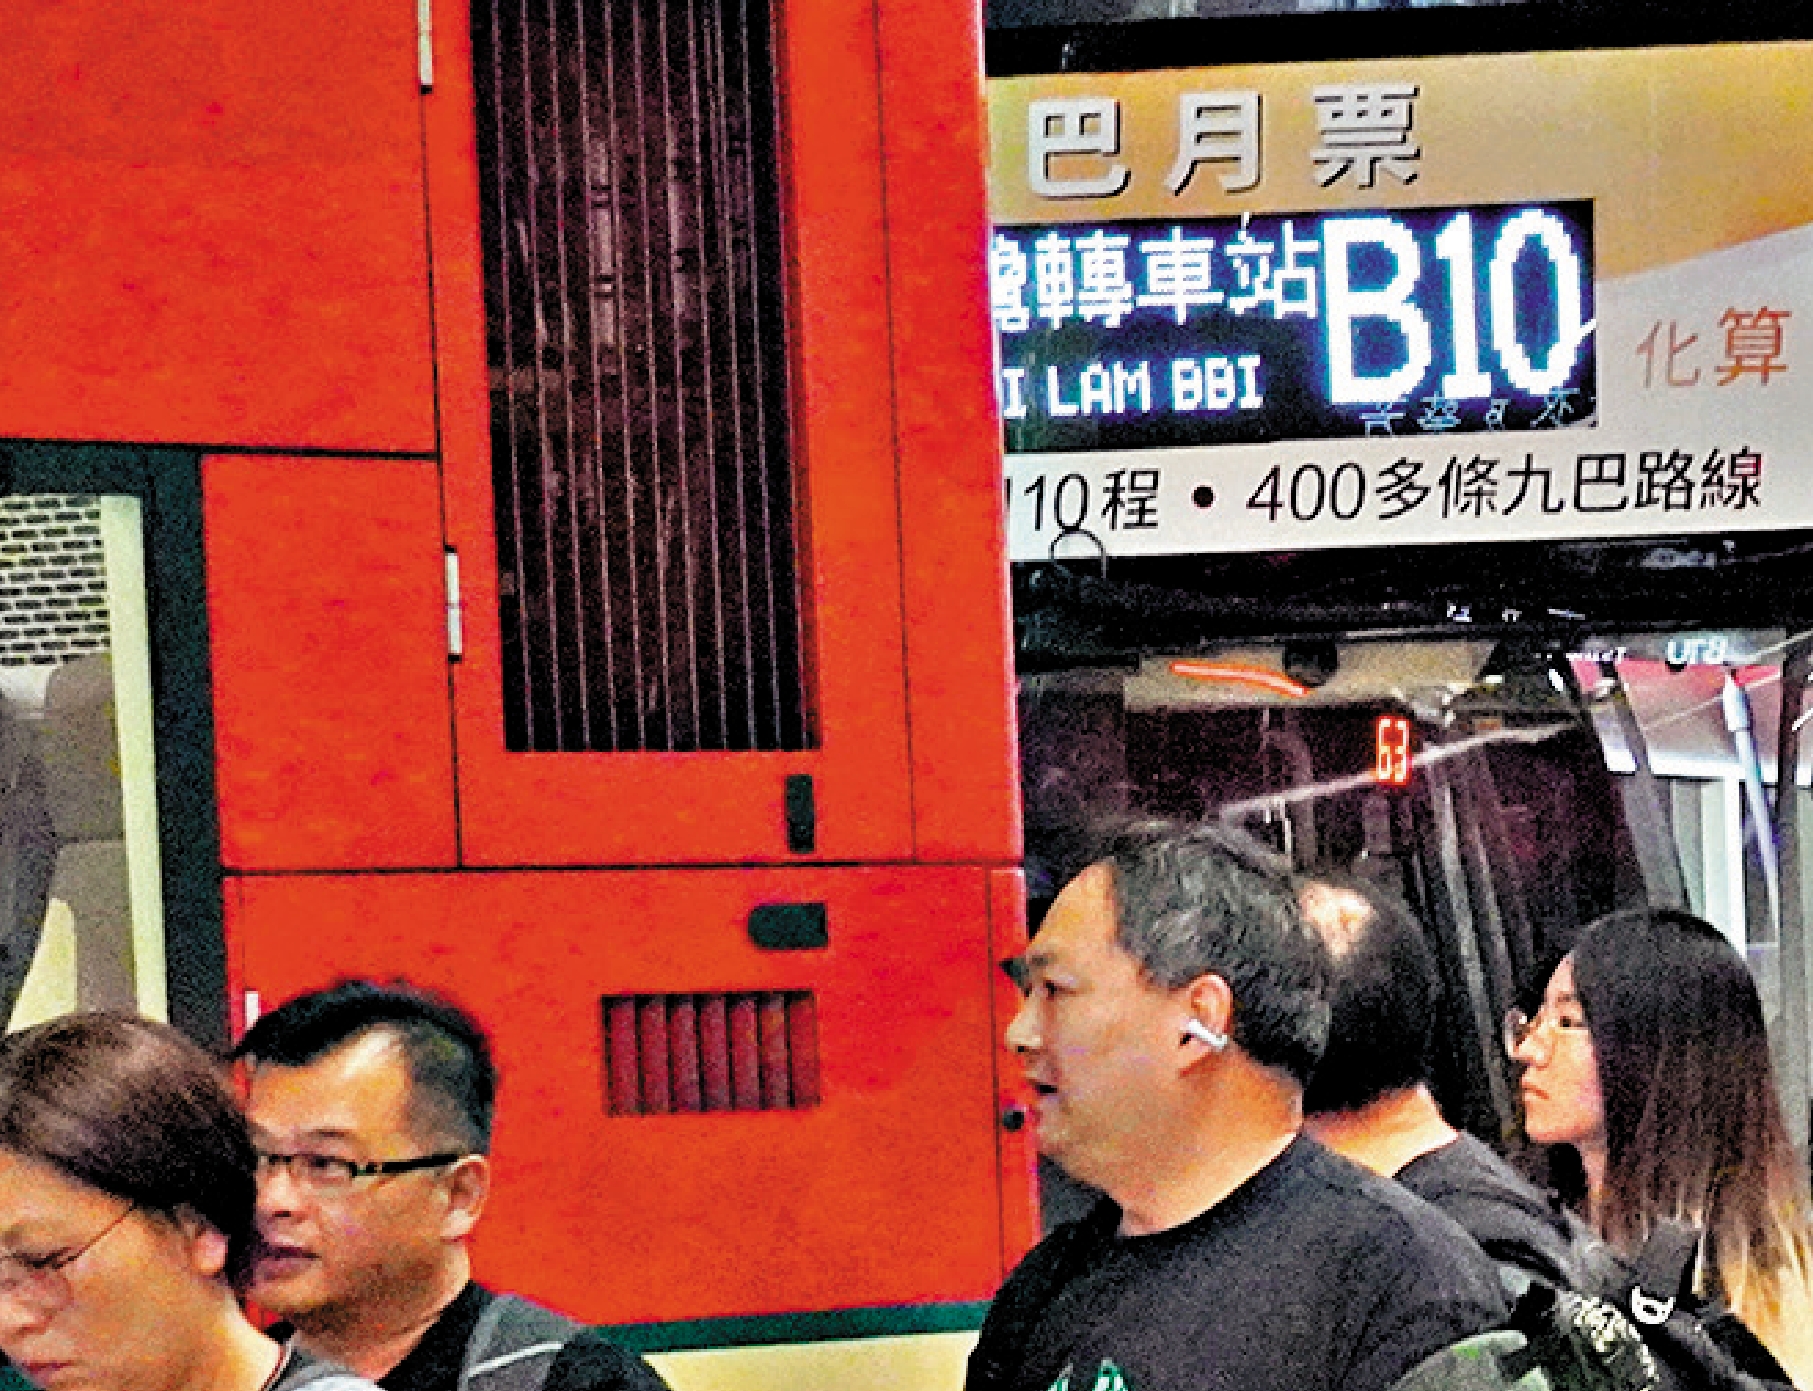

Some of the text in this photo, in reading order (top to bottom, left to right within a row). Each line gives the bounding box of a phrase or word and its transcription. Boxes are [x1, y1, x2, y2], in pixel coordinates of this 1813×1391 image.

[1026, 82, 1422, 196] 巴月票
[1325, 209, 1584, 404] B10
[1046, 361, 1152, 417] LAM
[1172, 355, 1263, 411] BBI
[1005, 466, 1161, 531] 10程
